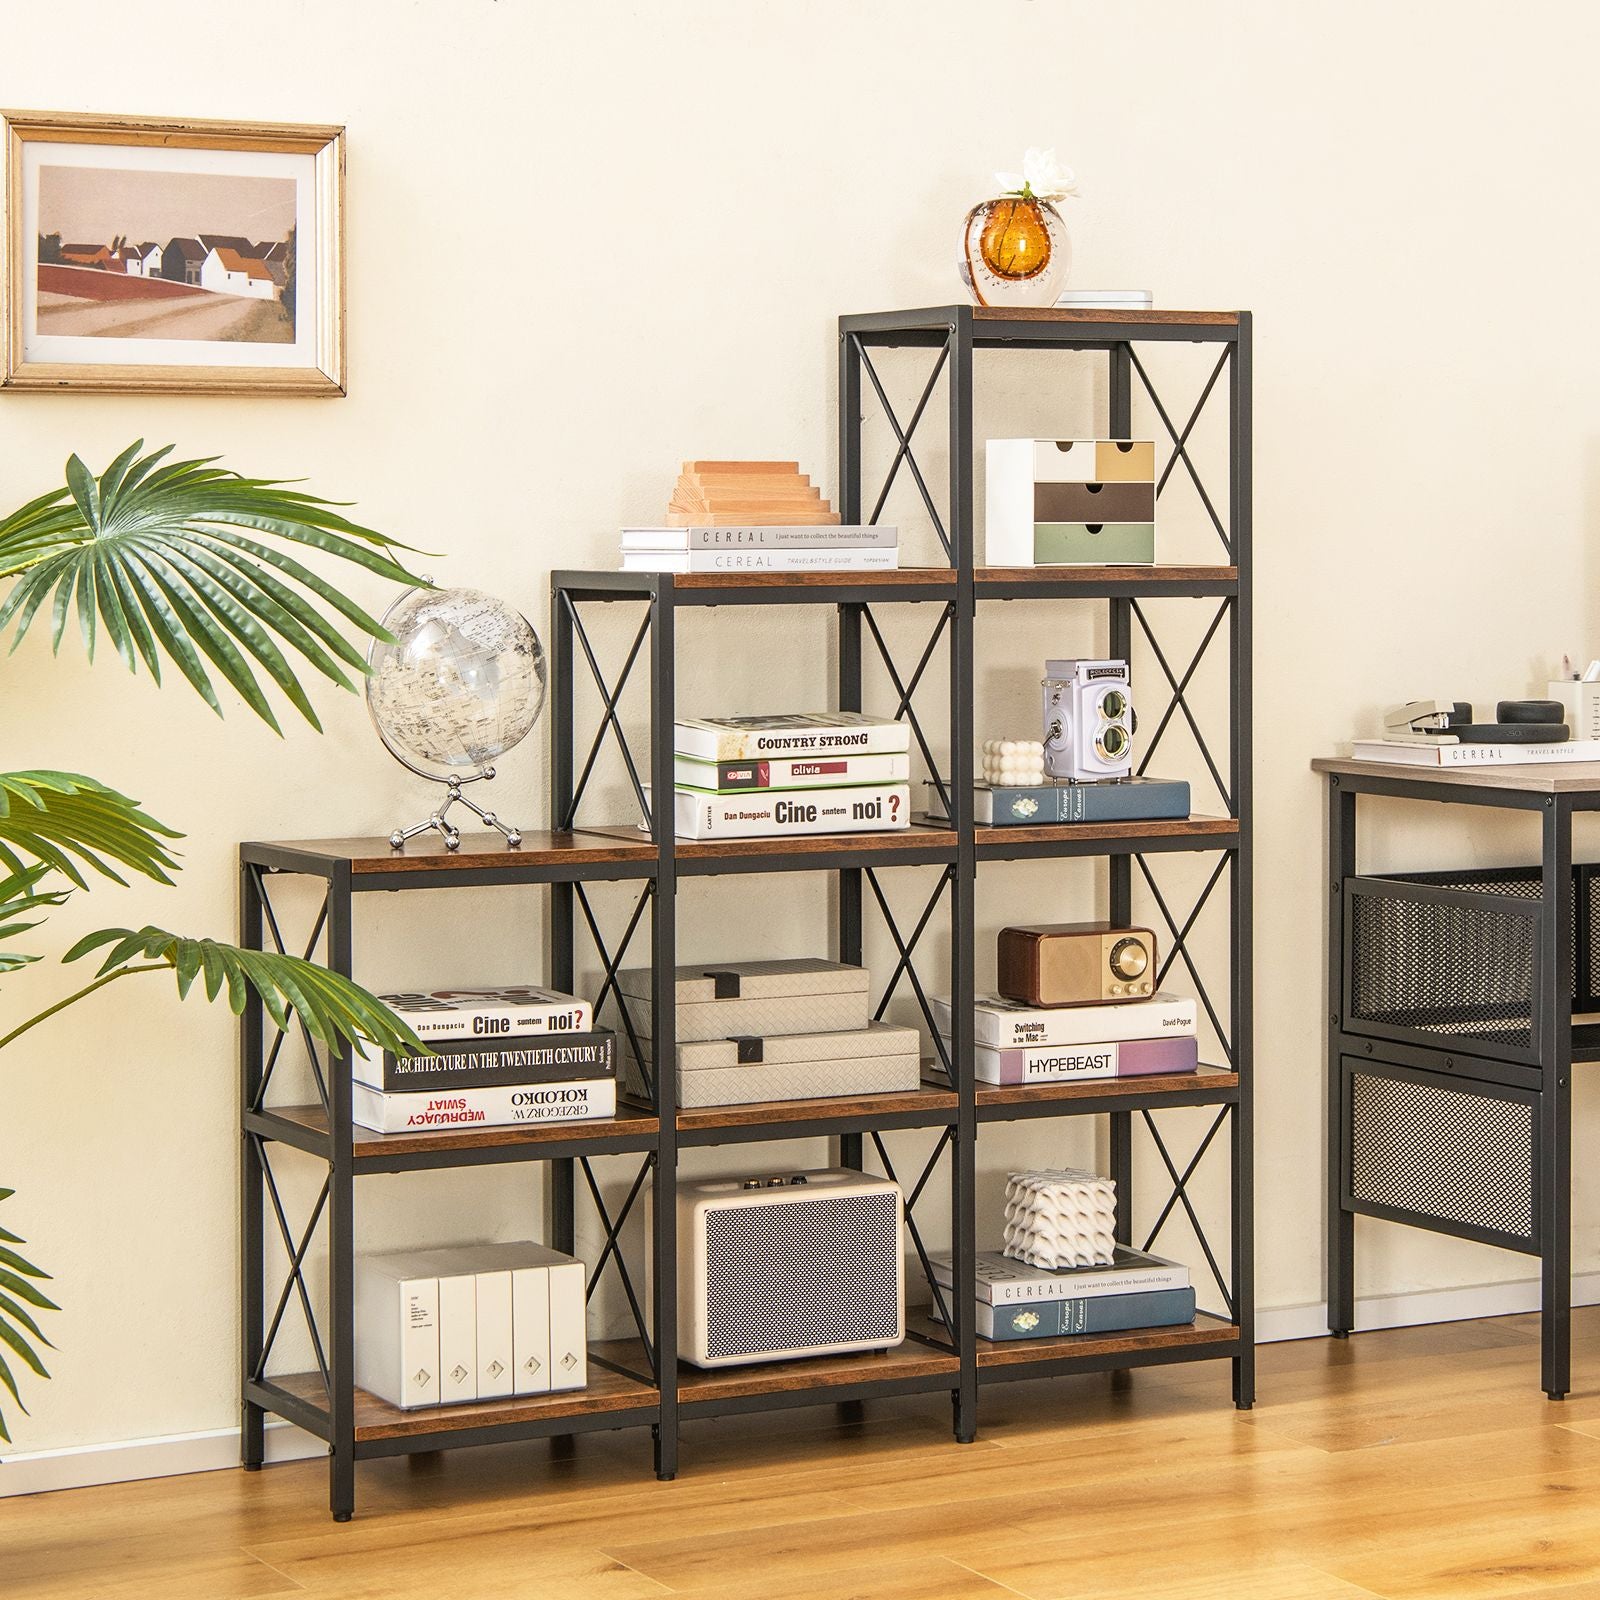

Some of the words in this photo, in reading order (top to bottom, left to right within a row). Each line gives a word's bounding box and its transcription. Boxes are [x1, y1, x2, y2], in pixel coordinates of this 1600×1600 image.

[703, 532, 764, 542] CEREAL
[779, 533, 789, 541] just
[715, 556, 773, 567] CEREAL
[757, 737, 816, 749] COUNTRY
[819, 733, 868, 746] STRONG
[1453, 750, 1502, 760] CEREAL
[793, 765, 820, 775] olivia
[724, 812, 738, 820] Dan
[739, 810, 771, 820] Dungaciu
[775, 801, 817, 823] Cine
[853, 797, 881, 819] noi
[888, 795, 900, 822] ?
[432, 1022, 465, 1030] Dungaciu
[473, 1016, 510, 1034] Cine
[517, 1017, 542, 1026] suntem
[1014, 1022, 1045, 1033] Switching
[1162, 1018, 1176, 1026] David
[1177, 1018, 1192, 1026] Pogue
[1025, 1033, 1039, 1042] Mac
[468, 1053, 479, 1069] IN
[480, 1052, 499, 1068] THE
[500, 1048, 554, 1067] TWENTIETH
[554, 1045, 597, 1064] CENTURY
[1029, 1055, 1112, 1074] HYPEBEAST
[511, 1089, 588, 1106] KOŁODKO
[427, 1098, 467, 1111] ŚWIAT
[527, 1104, 589, 1119] GRZEGORZ
[1077, 1282, 1087, 1291] just
[1132, 1277, 1156, 1285] beautiful
[1005, 1284, 1063, 1298] CEREAL
